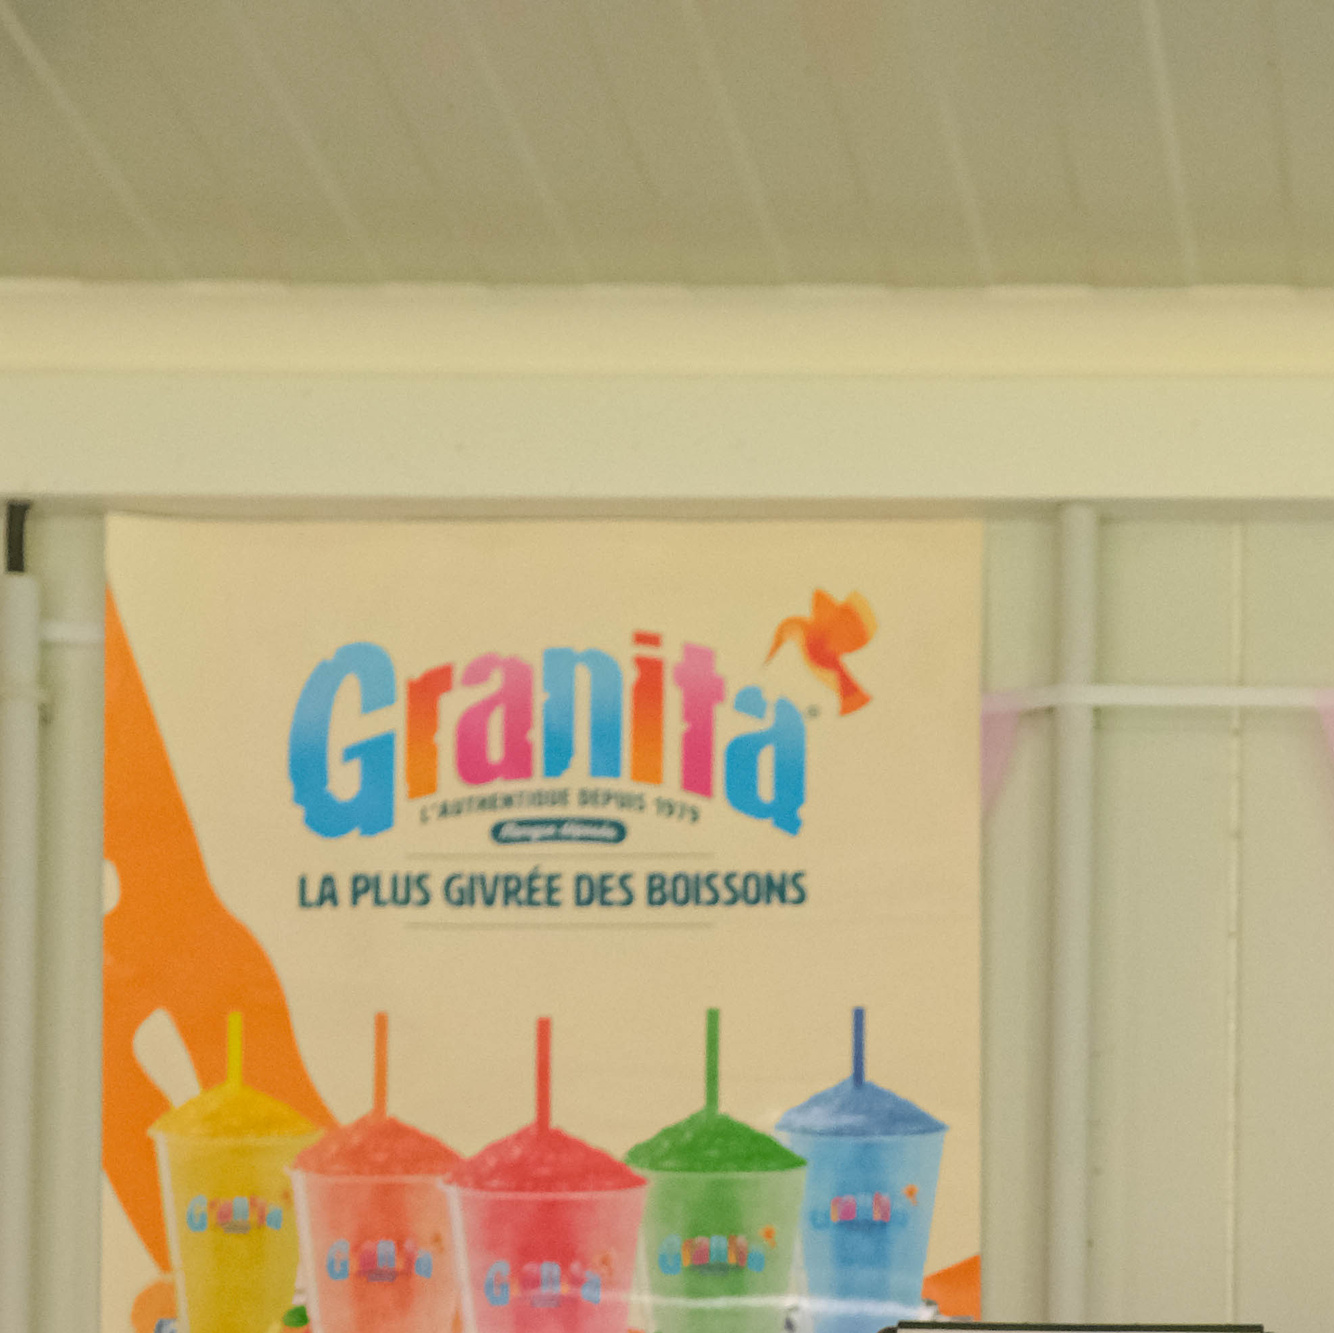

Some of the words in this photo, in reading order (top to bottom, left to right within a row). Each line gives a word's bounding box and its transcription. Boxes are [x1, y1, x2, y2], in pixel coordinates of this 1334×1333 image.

[288, 629, 808, 838] Granita
[298, 873, 338, 909] LA
[351, 872, 431, 909] PLUS
[444, 865, 562, 908] GIVRÉE
[575, 872, 634, 908] DES
[646, 870, 808, 907] BOISSONS
